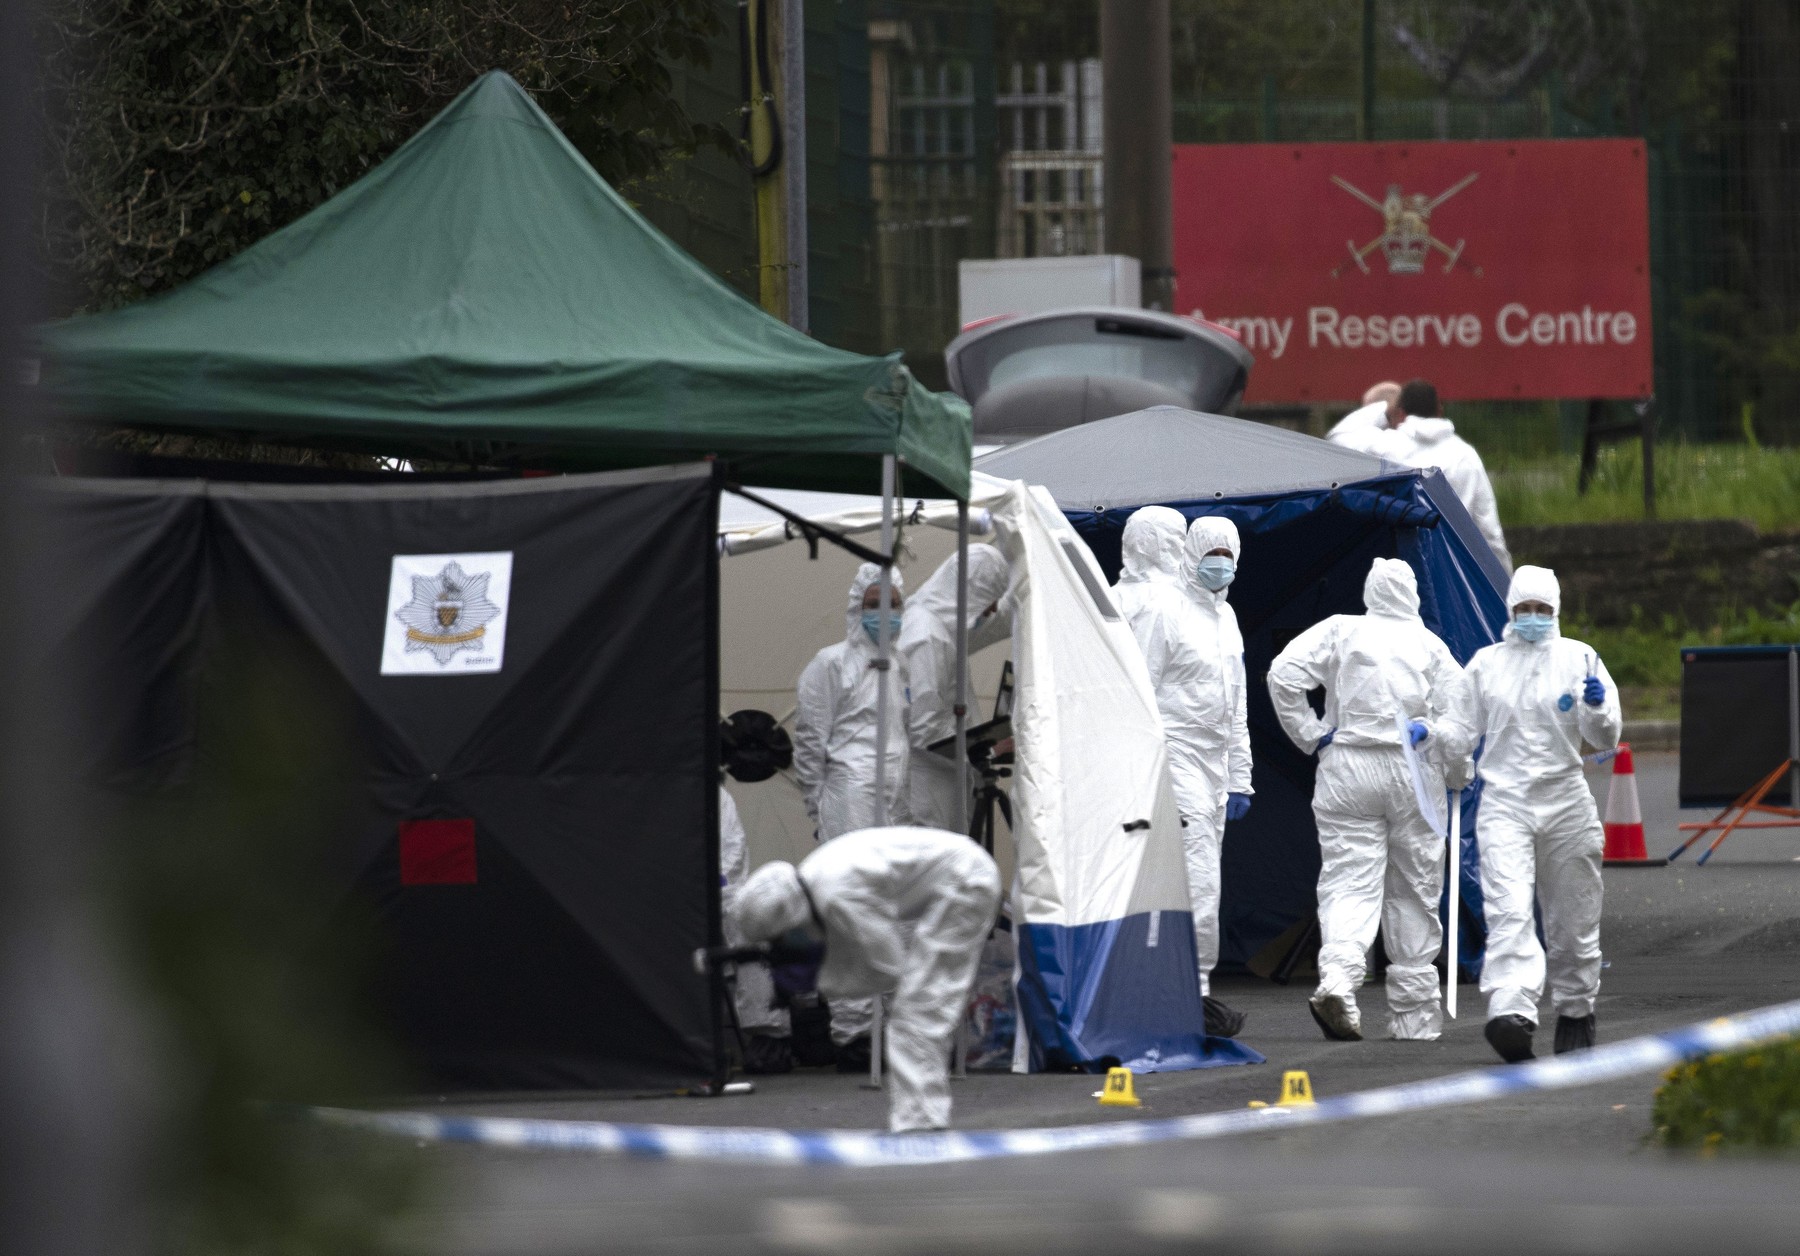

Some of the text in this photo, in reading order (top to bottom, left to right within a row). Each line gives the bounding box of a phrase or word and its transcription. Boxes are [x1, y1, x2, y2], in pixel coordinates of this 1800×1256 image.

[1308, 305, 1482, 349] Reserve
[1495, 302, 1638, 347] Centre
[1289, 1078, 1306, 1097] 14
